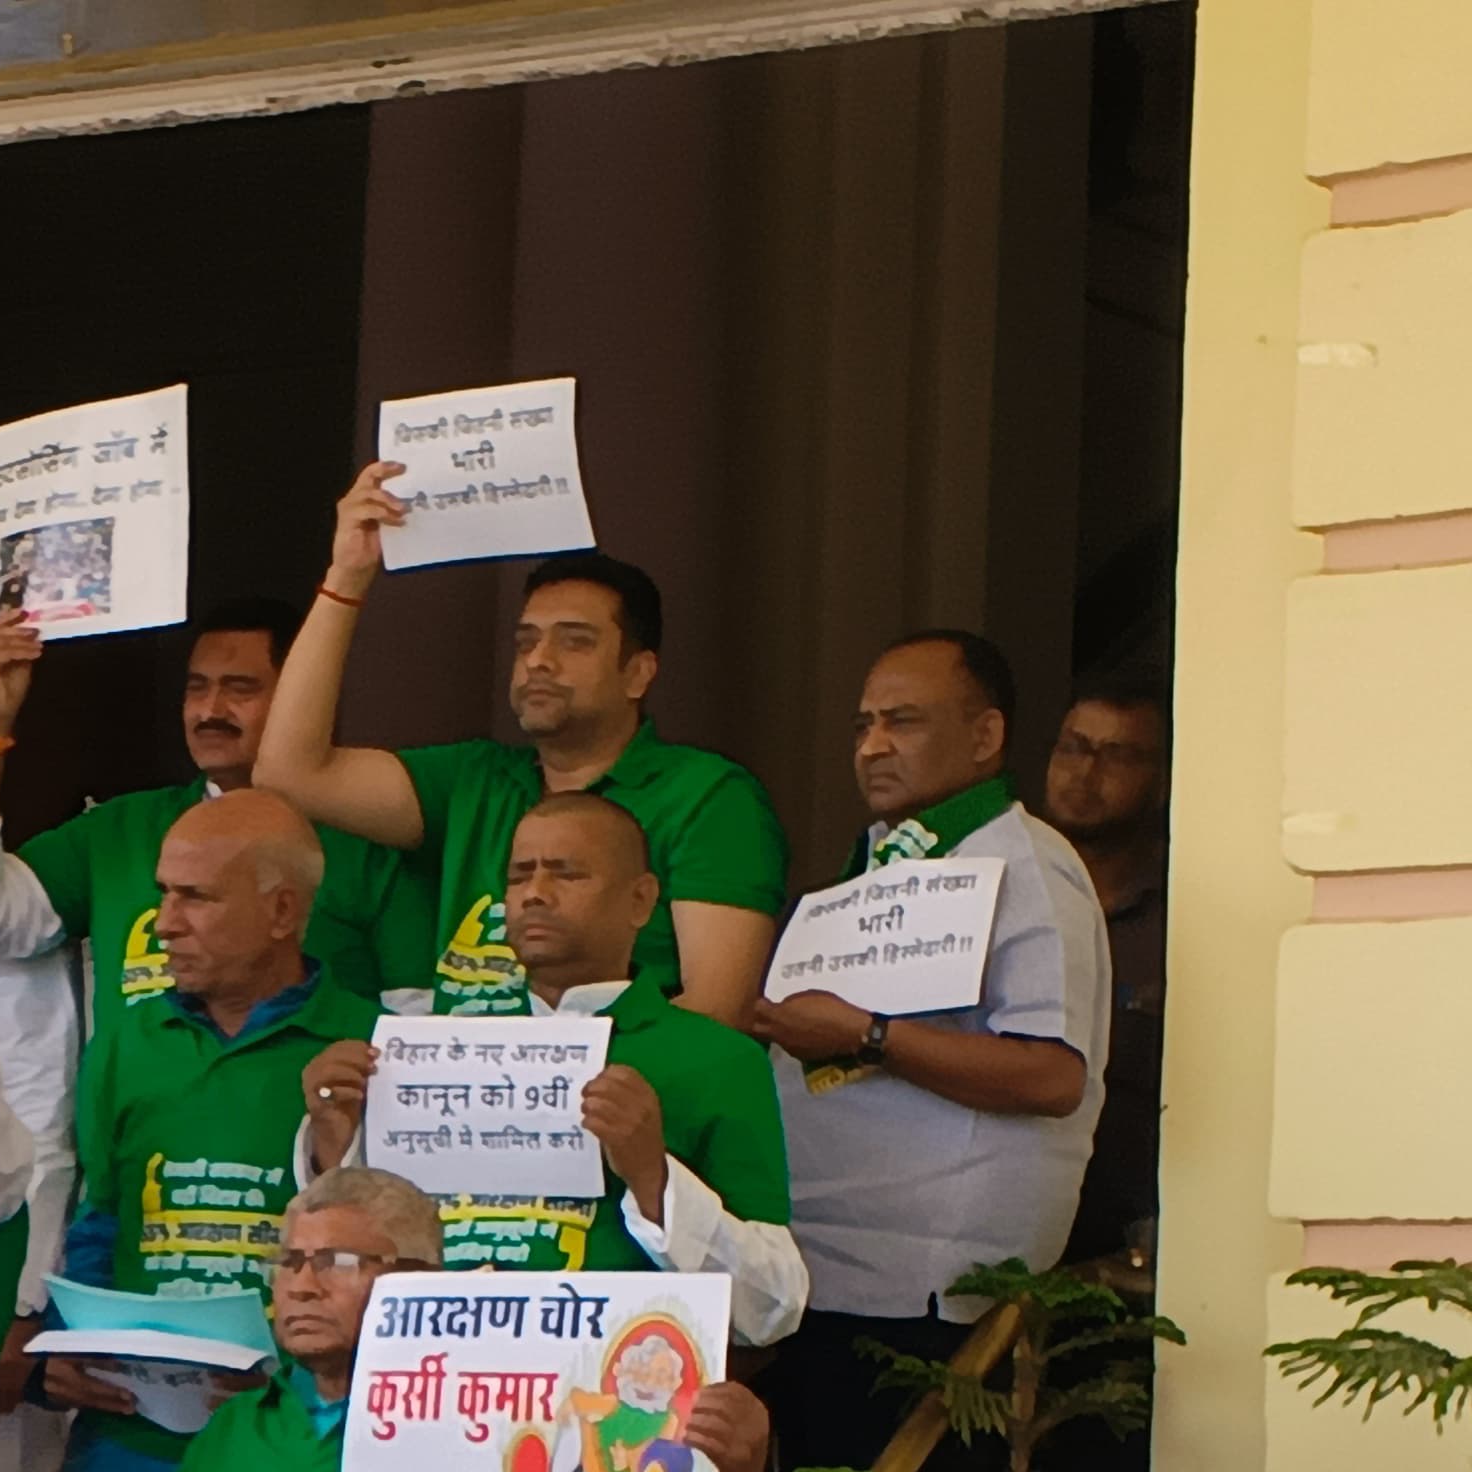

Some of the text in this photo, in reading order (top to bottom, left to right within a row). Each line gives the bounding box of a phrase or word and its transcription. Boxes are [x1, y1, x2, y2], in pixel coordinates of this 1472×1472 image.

[858, 905, 905, 935] भारी
[447, 1036, 468, 1061] के
[475, 1044, 506, 1066] नए
[510, 1044, 589, 1066] आरक्षण
[396, 1074, 574, 1116] कानून को 9वीं
[375, 1283, 609, 1339] आरक्षण चोर
[366, 1352, 558, 1443] कुर्सी कुमार
